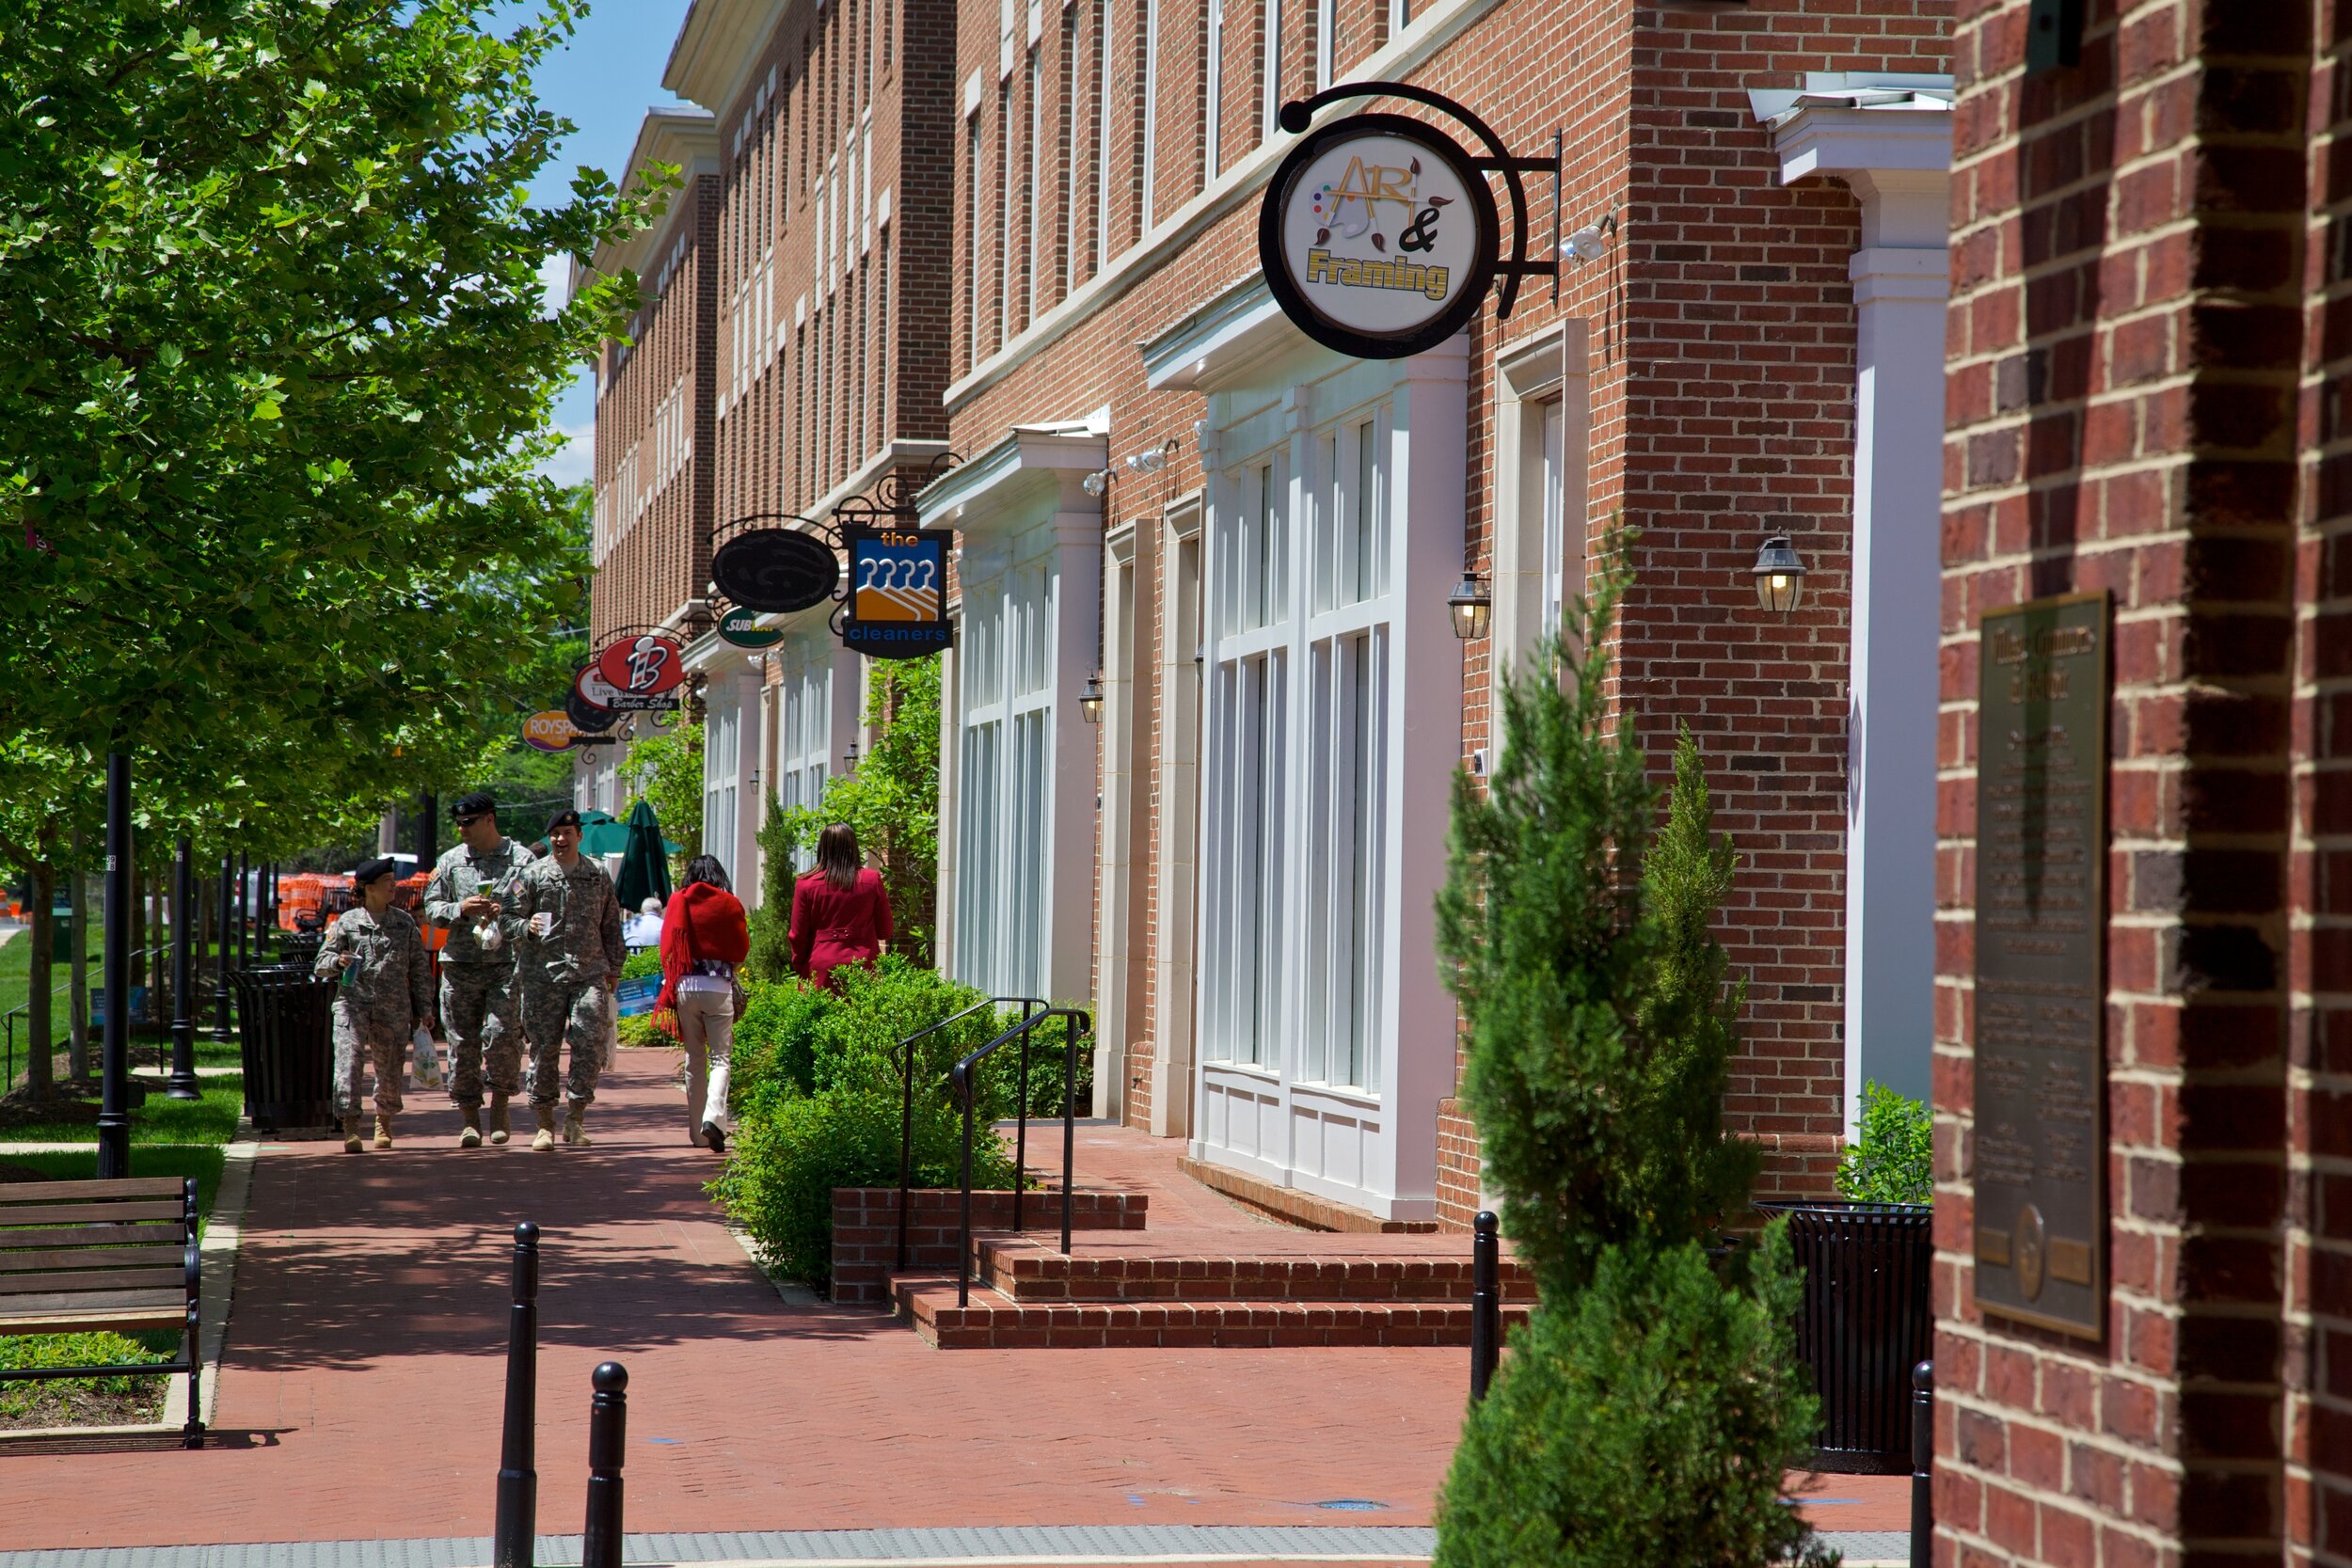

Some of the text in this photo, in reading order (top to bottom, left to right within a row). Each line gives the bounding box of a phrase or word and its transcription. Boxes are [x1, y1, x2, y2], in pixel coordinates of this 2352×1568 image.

[1398, 207, 1441, 253] &
[1306, 248, 1450, 301] Framing
[881, 531, 919, 548] the
[849, 626, 946, 641] cleaners
[592, 687, 614, 697] Live
[612, 698, 673, 709] Barber Shop
